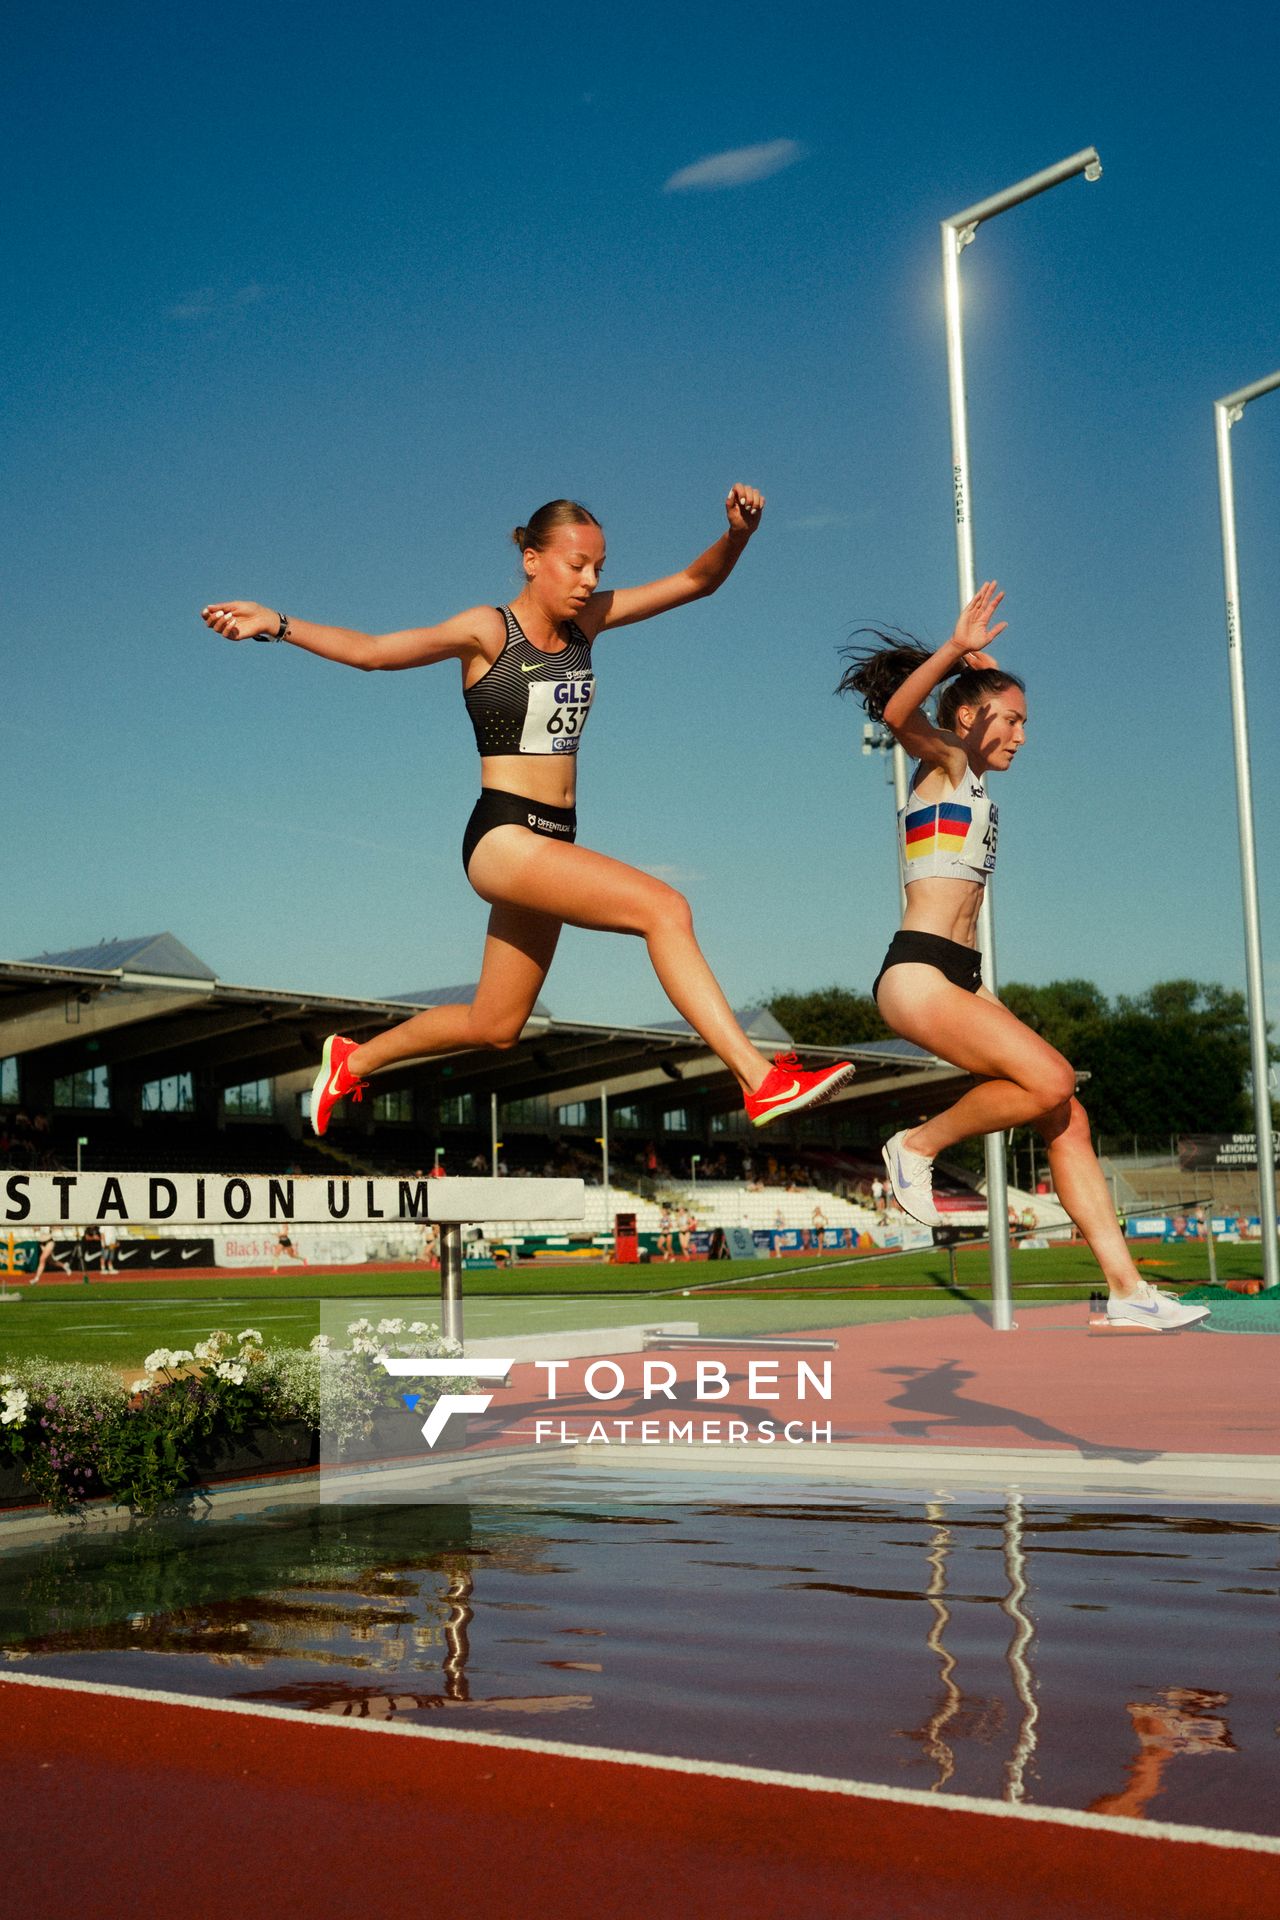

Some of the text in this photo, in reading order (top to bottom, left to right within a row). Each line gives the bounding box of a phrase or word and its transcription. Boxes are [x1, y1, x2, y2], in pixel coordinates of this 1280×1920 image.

[954, 465, 965, 524] SCHAPER
[554, 683, 591, 704] GLS
[546, 706, 590, 735] 637
[5, 1175, 429, 1221] STADION ULM
[226, 1241, 259, 1257] Black
